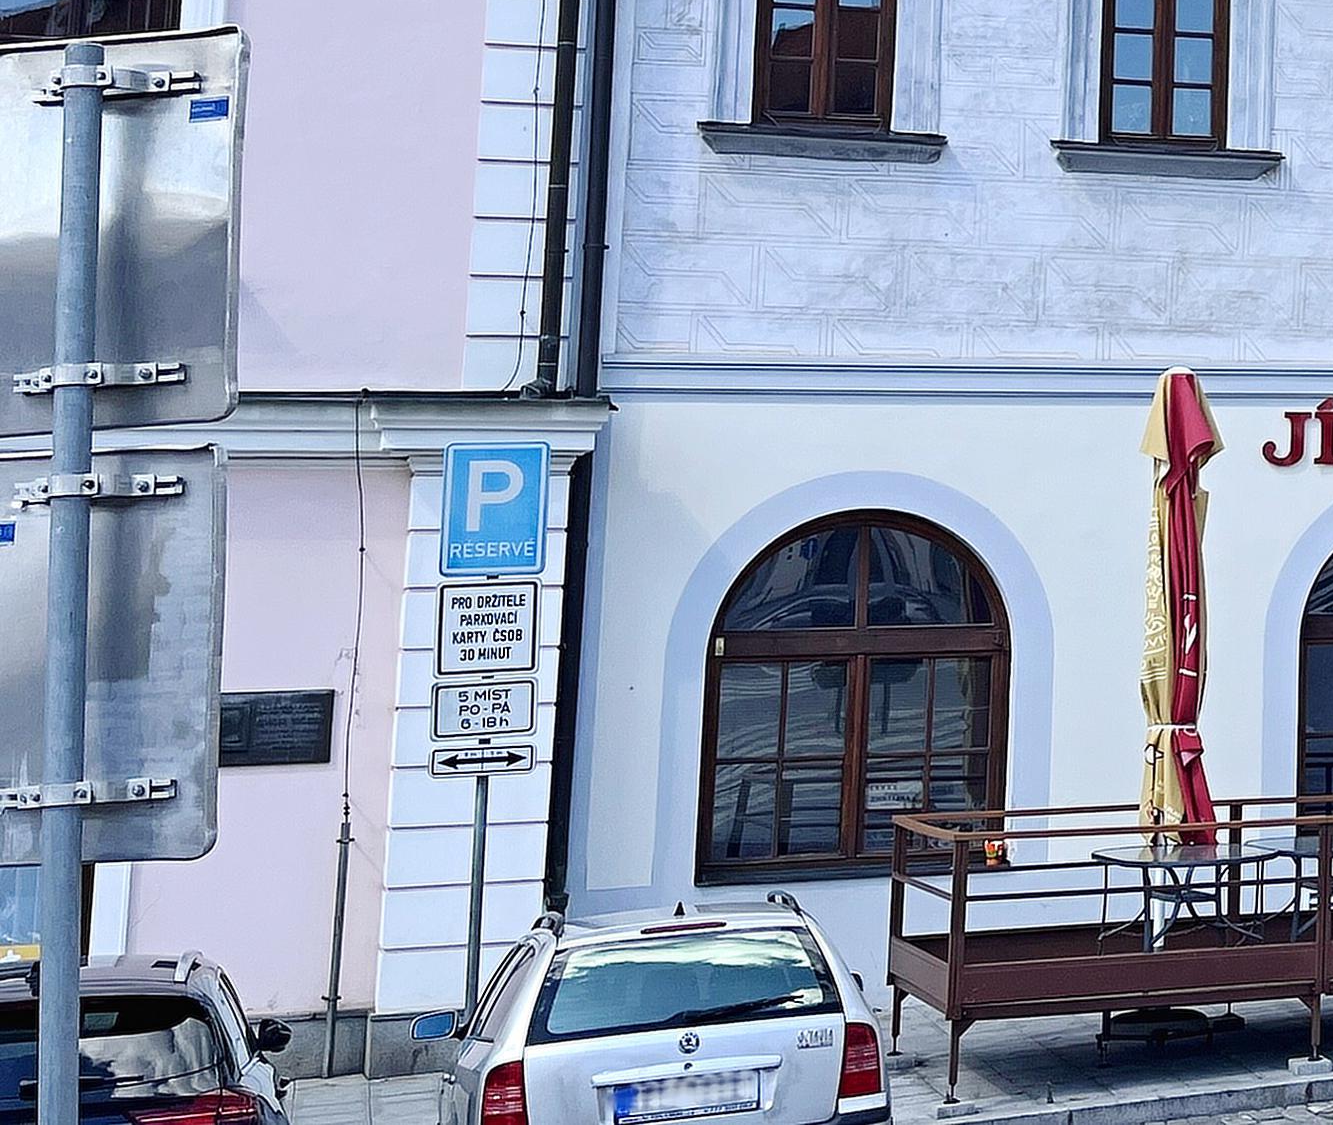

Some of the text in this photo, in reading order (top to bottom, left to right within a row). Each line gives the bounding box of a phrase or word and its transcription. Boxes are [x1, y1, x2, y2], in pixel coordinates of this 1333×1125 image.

[465, 459, 524, 532] P
[450, 537, 536, 559] RÉSERVÉ
[451, 594, 526, 610] PRO DRŽITELE
[452, 628, 523, 645] KARTY ČSOB
[459, 646, 512, 662] 30 MINUT
[458, 691, 469, 703] 5
